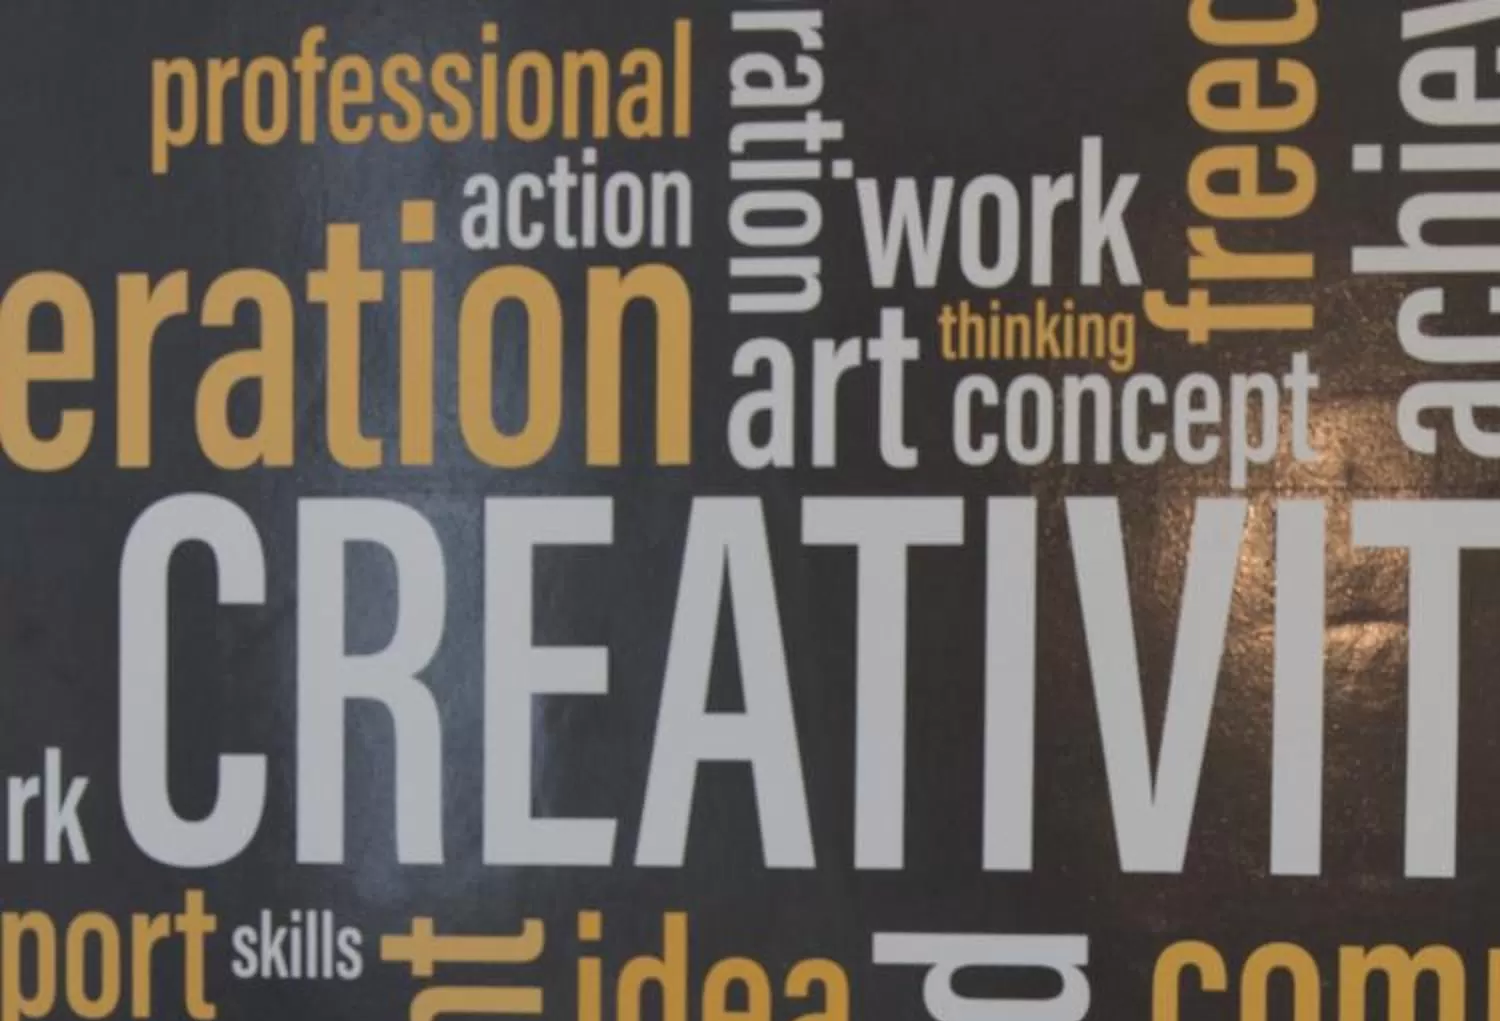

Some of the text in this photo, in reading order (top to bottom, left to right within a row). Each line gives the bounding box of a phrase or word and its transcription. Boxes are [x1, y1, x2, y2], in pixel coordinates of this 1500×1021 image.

[153, 20, 692, 172] professional
[729, 10, 854, 313] ration
[461, 148, 692, 250] action
[855, 136, 1142, 289] work
[0, 201, 692, 471] eration
[728, 307, 920, 469] art
[940, 300, 1137, 374] thinking
[953, 352, 1319, 489] concept
[232, 909, 363, 980] skills
